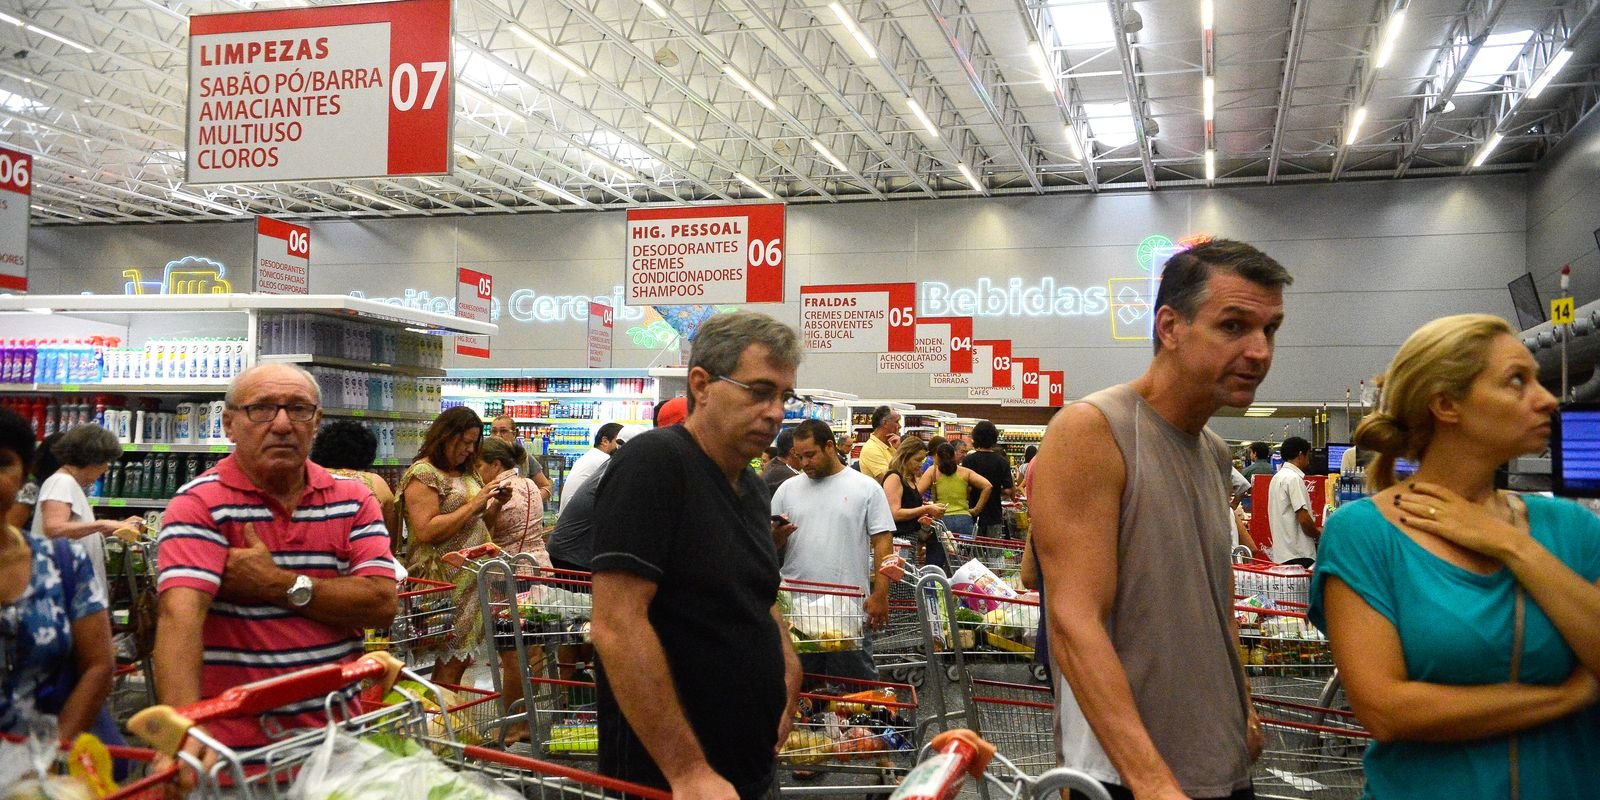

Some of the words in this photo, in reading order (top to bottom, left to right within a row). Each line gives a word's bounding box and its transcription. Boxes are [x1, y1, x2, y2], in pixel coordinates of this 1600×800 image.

[200, 37, 329, 66] LIMPEZAS
[200, 72, 270, 97] SABÃO
[275, 67, 383, 94] PÓ/BARRA
[391, 61, 447, 112] 07
[199, 94, 341, 121] AMACIANTES
[199, 121, 302, 145] MULTIUSO
[197, 147, 279, 169] CLOROS
[0, 154, 29, 187] 06
[632, 226, 665, 239] HIG.
[671, 222, 741, 237] PESSOAL
[289, 229, 308, 254] 06
[632, 241, 738, 257] DESODORANTES
[748, 238, 782, 267] 06
[260, 259, 305, 274] DESODORANTES
[632, 257, 684, 271] CREMES
[632, 268, 743, 284] CONDICIONADORES
[479, 277, 491, 296] 05
[632, 284, 704, 298] SHAMPOOS
[804, 297, 857, 307] FRALDAS
[922, 277, 1108, 316] Bebidas
[804, 310, 841, 320] CREMES
[844, 310, 884, 319] DENTAIS
[889, 306, 914, 327] 05
[1555, 303, 1570, 320] 14
[804, 320, 873, 329] ABSORVENTES
[804, 330, 822, 339] HIG.
[824, 330, 854, 339] BUCAL
[804, 339, 832, 349] MEIAS
[950, 336, 972, 351] 04
[880, 354, 947, 362] ACHOCOLATADOS
[993, 356, 1011, 371] 03
[1023, 372, 1038, 384] 02
[1050, 384, 1062, 394] 01
